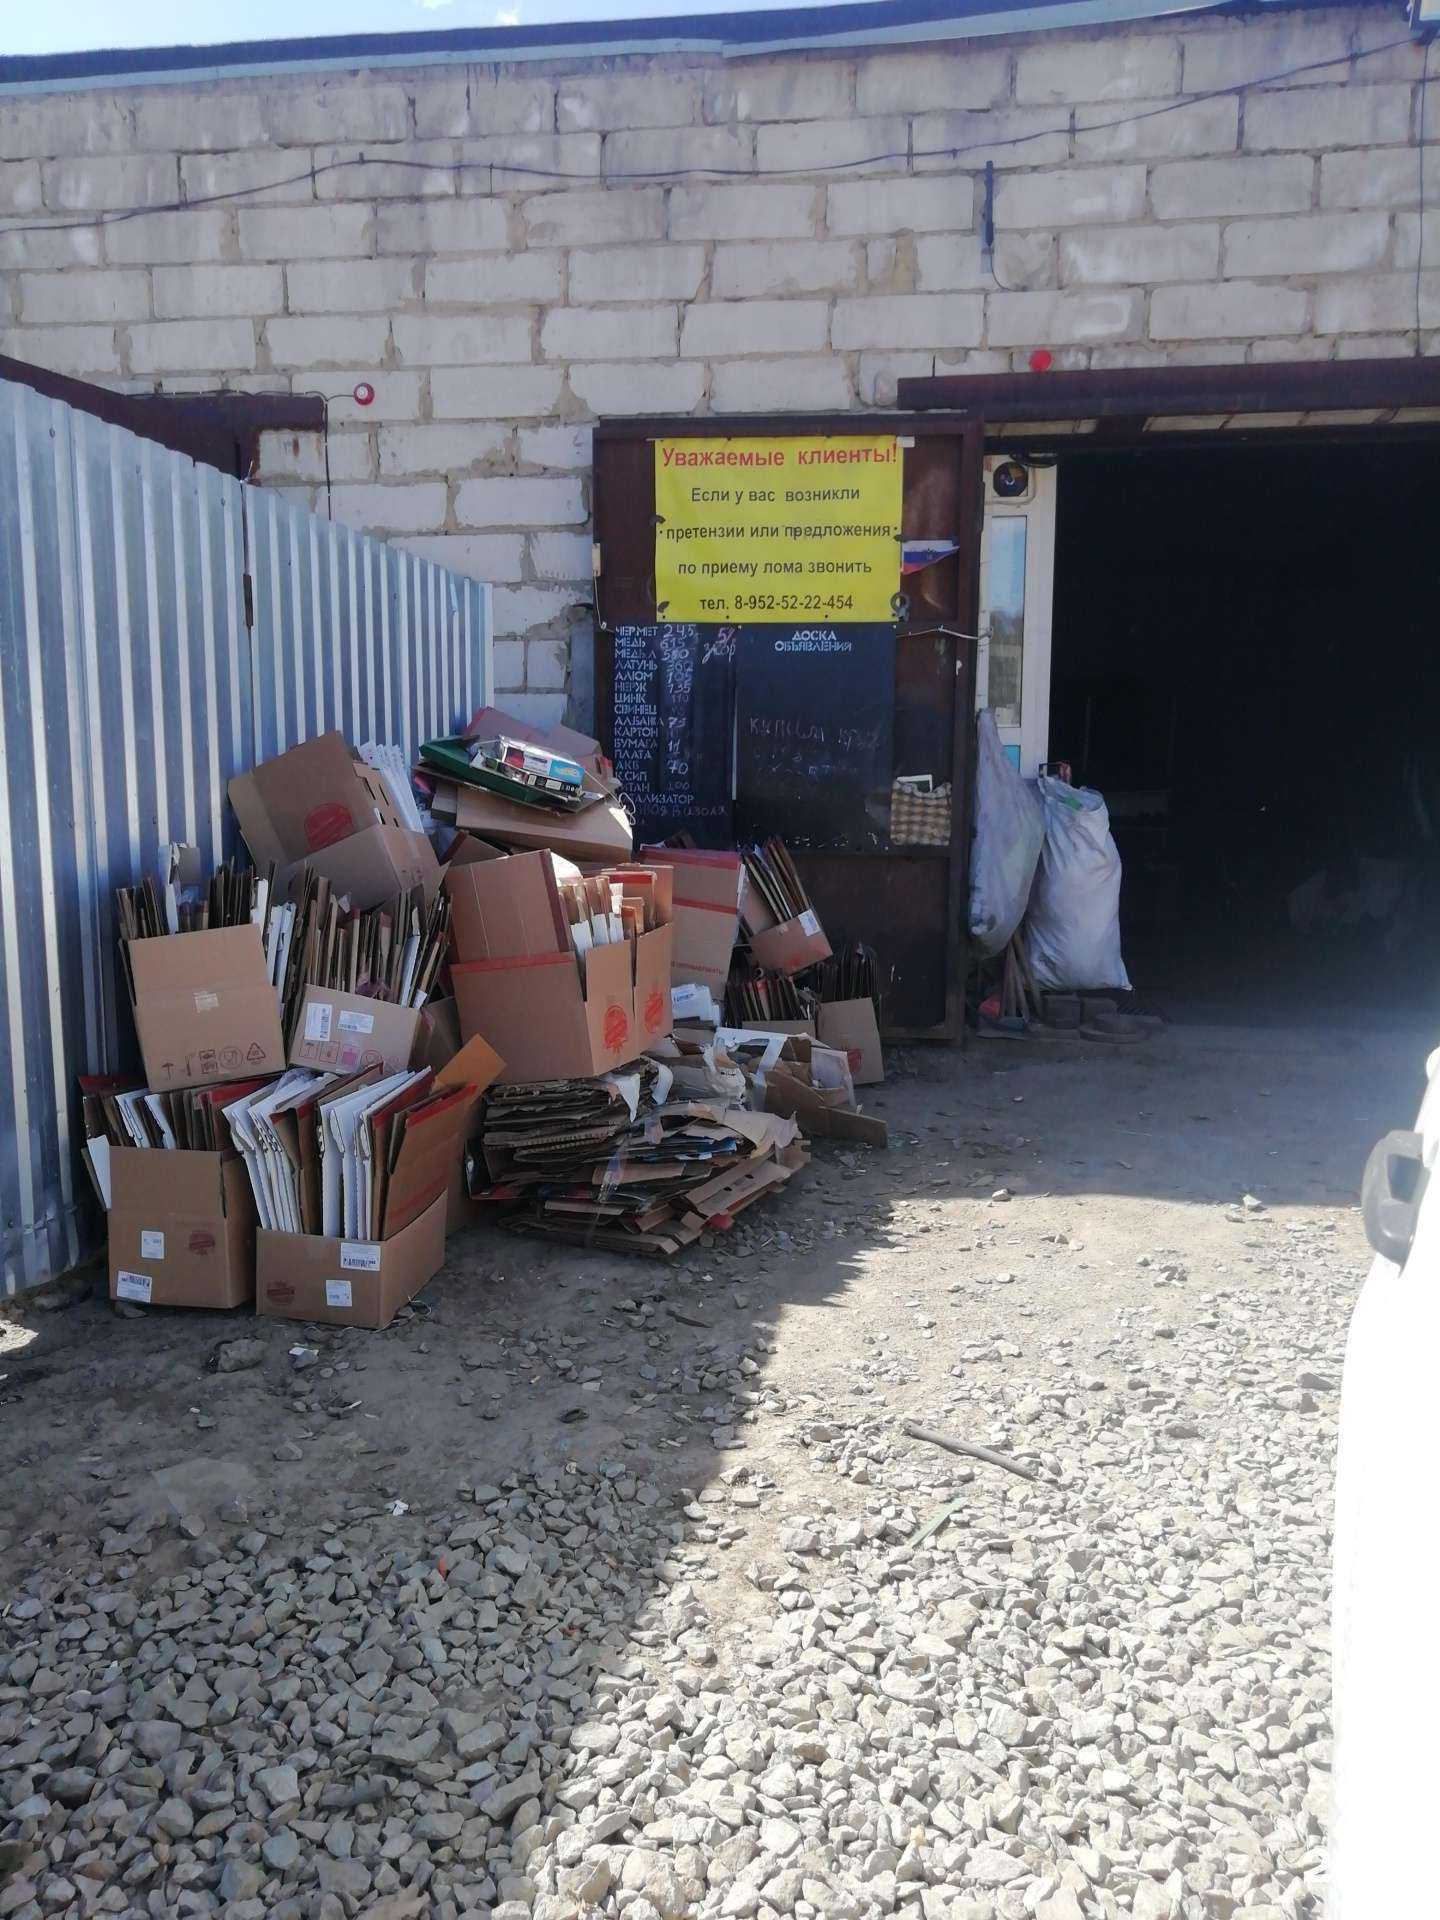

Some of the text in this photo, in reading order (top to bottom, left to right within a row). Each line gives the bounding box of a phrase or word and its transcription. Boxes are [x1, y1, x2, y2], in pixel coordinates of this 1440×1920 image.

[662, 443, 897, 468] Уважаемые клиенты!
[691, 487, 860, 506] Если у вас возникли
[666, 524, 891, 541] претензии или предложения
[678, 561, 872, 578] по приему лома звонить
[700, 594, 854, 611] тел. 8-952-52-22-454
[615, 625, 658, 638] ЧЕРМЕТ
[791, 630, 837, 642] ДОСКА
[615, 637, 647, 649] МЕДЬ
[774, 640, 852, 652] ОБЪЯВЛЕНИЯ
[615, 660, 658, 671] ЛАТУНЬ
[615, 671, 653, 682] АЛЮМ
[615, 682, 647, 693] НЕРЖ
[615, 693, 646, 704] ЦИНК
[615, 704, 658, 716] СВИНЕЦ
[615, 727, 658, 738] КАРТОН
[615, 738, 658, 749] БУМАГА
[615, 749, 652, 760] ПЛАТА
[616, 760, 640, 772] АКБ
